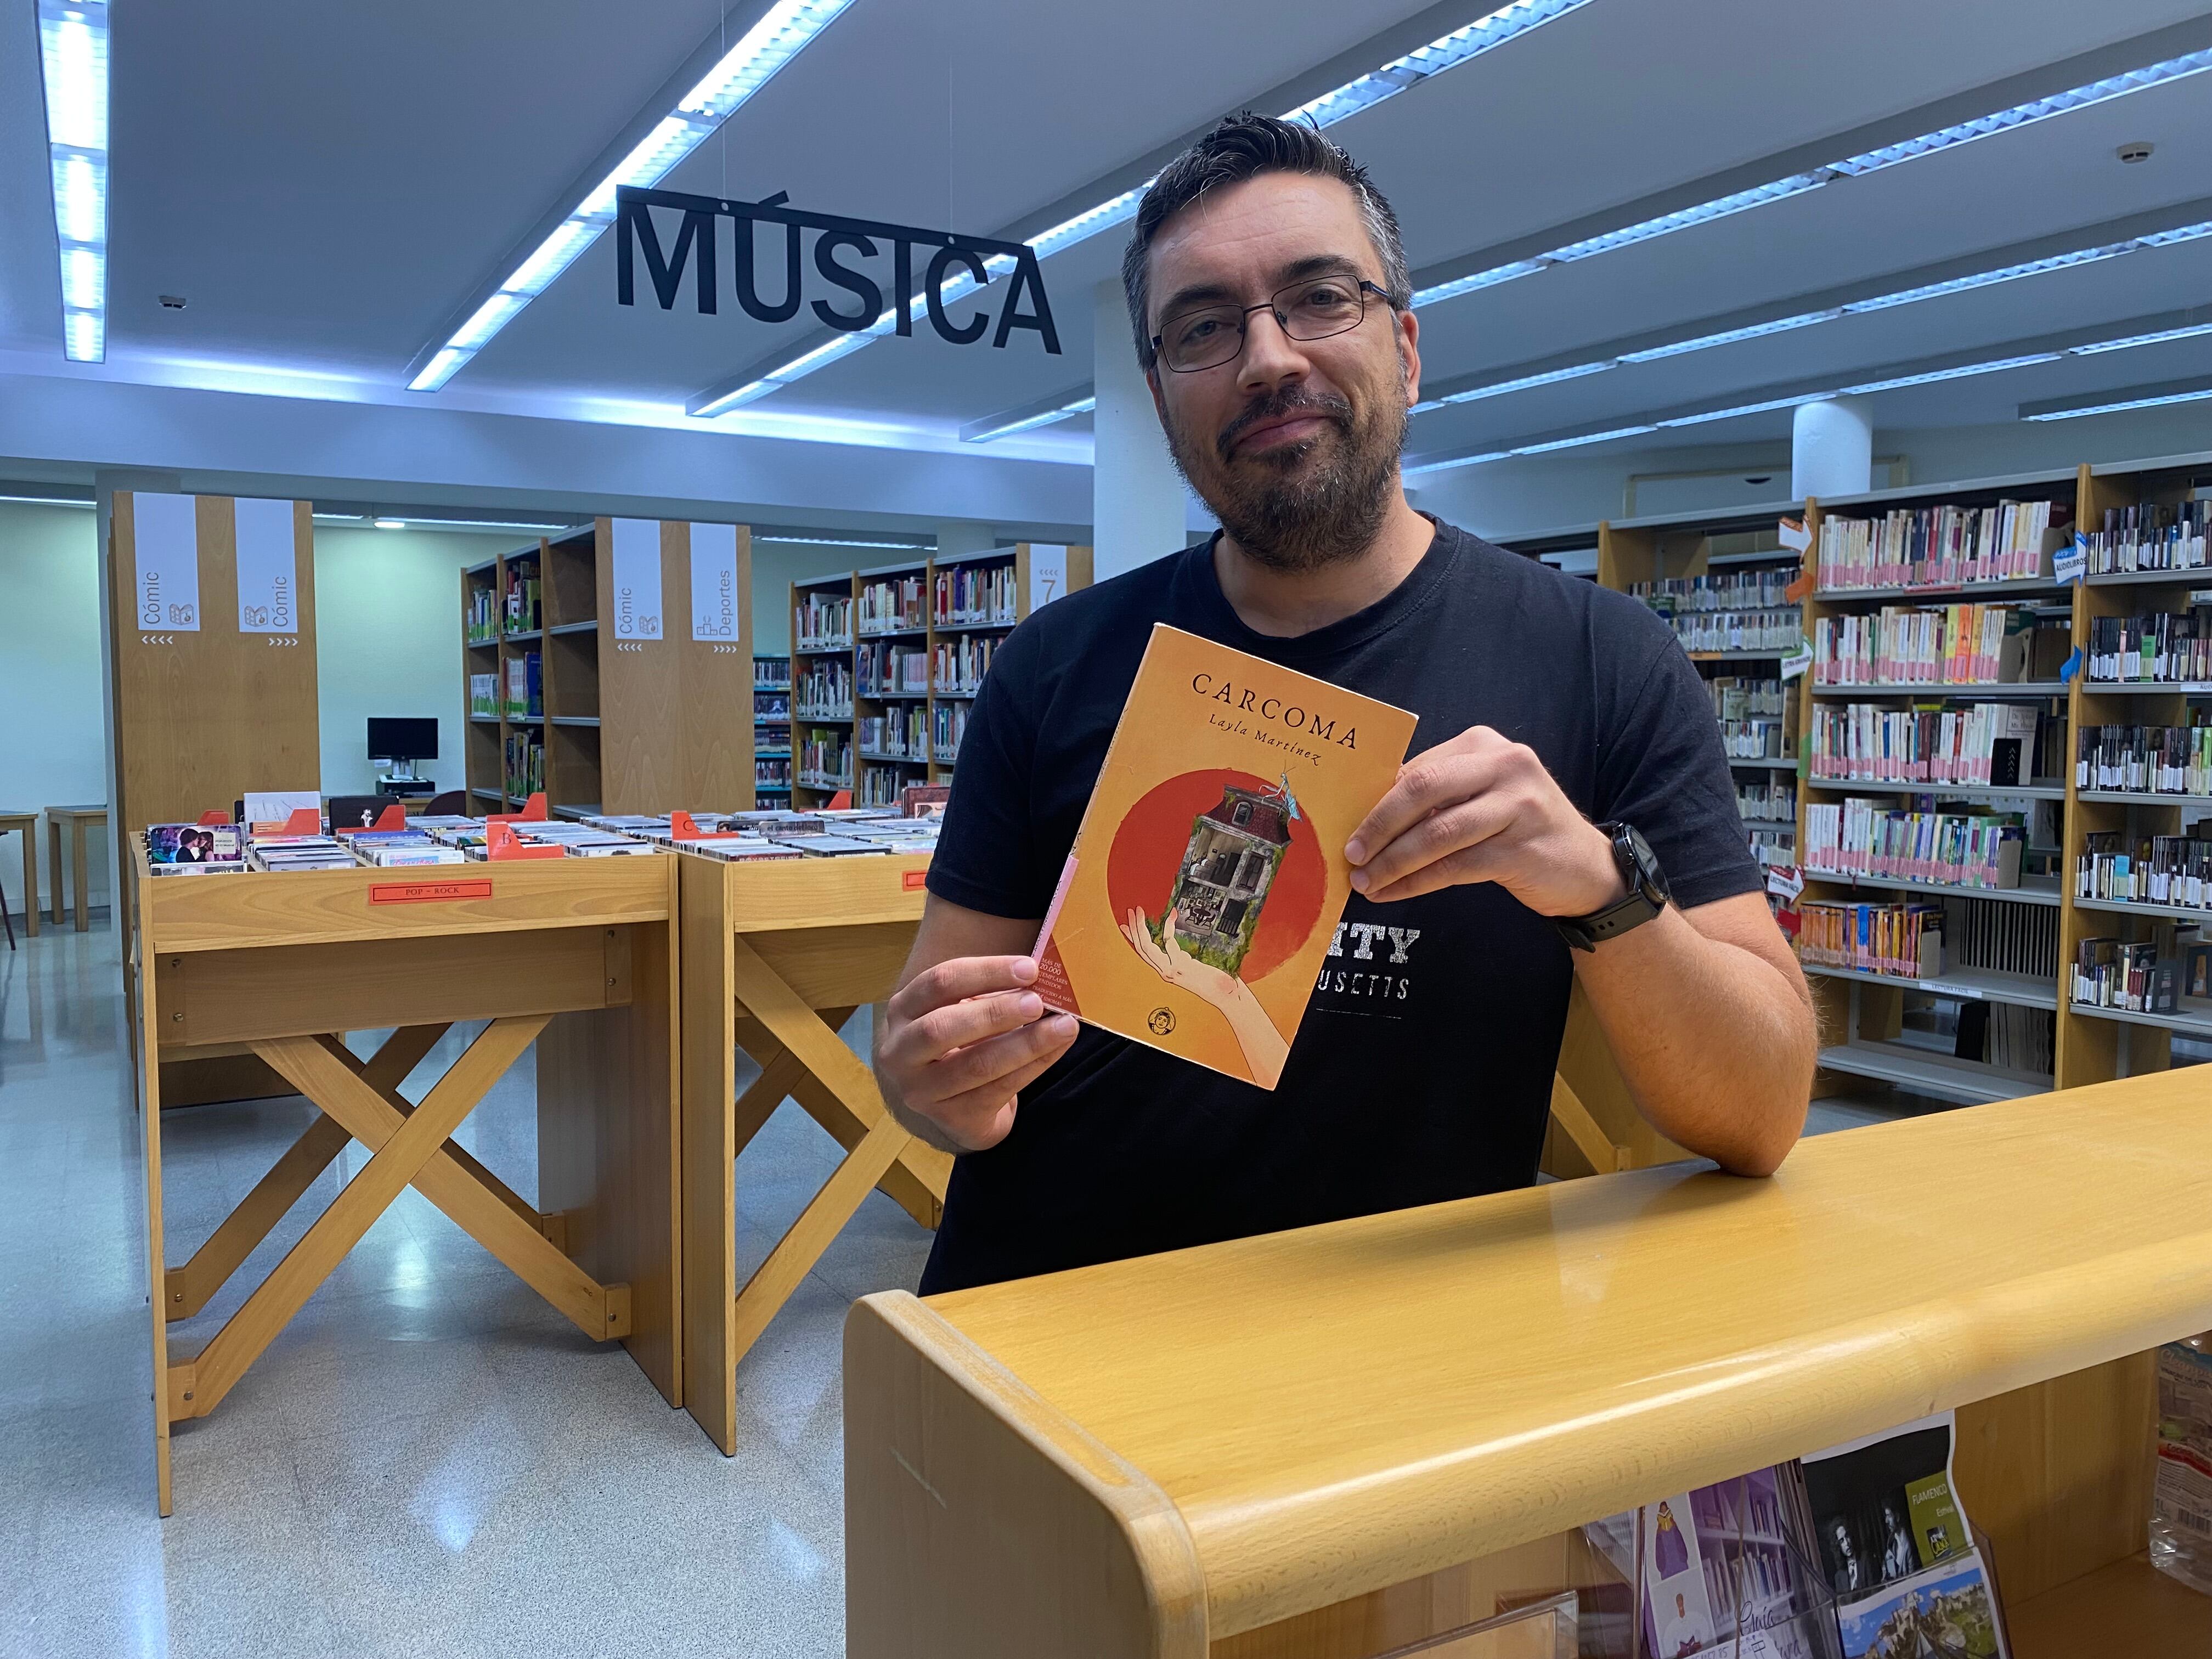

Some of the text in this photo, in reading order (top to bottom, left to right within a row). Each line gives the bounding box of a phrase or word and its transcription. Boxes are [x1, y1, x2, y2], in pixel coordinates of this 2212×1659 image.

[617, 185, 1062, 356] MÚSICA
[2056, 557, 2086, 571] AUDIOLIBROS
[143, 572, 161, 624] Cómic
[272, 576, 289, 627] Cómic
[719, 570, 733, 636] Deportes
[1041, 579, 1056, 604] 7
[619, 588, 632, 634] Cómic
[1192, 674, 1356, 749] CARCOMA
[1209, 714, 1322, 766] Layla Martínez
[683, 820, 695, 832] C
[502, 833, 511, 845] B
[434, 887, 460, 895] ROCK
[1039, 963, 1062, 975] 20.000
[1041, 957, 1053, 966] MÁS
[1038, 970, 1068, 985] JEMPLARES
[1912, 1483, 1948, 1505] FLAMENCO
